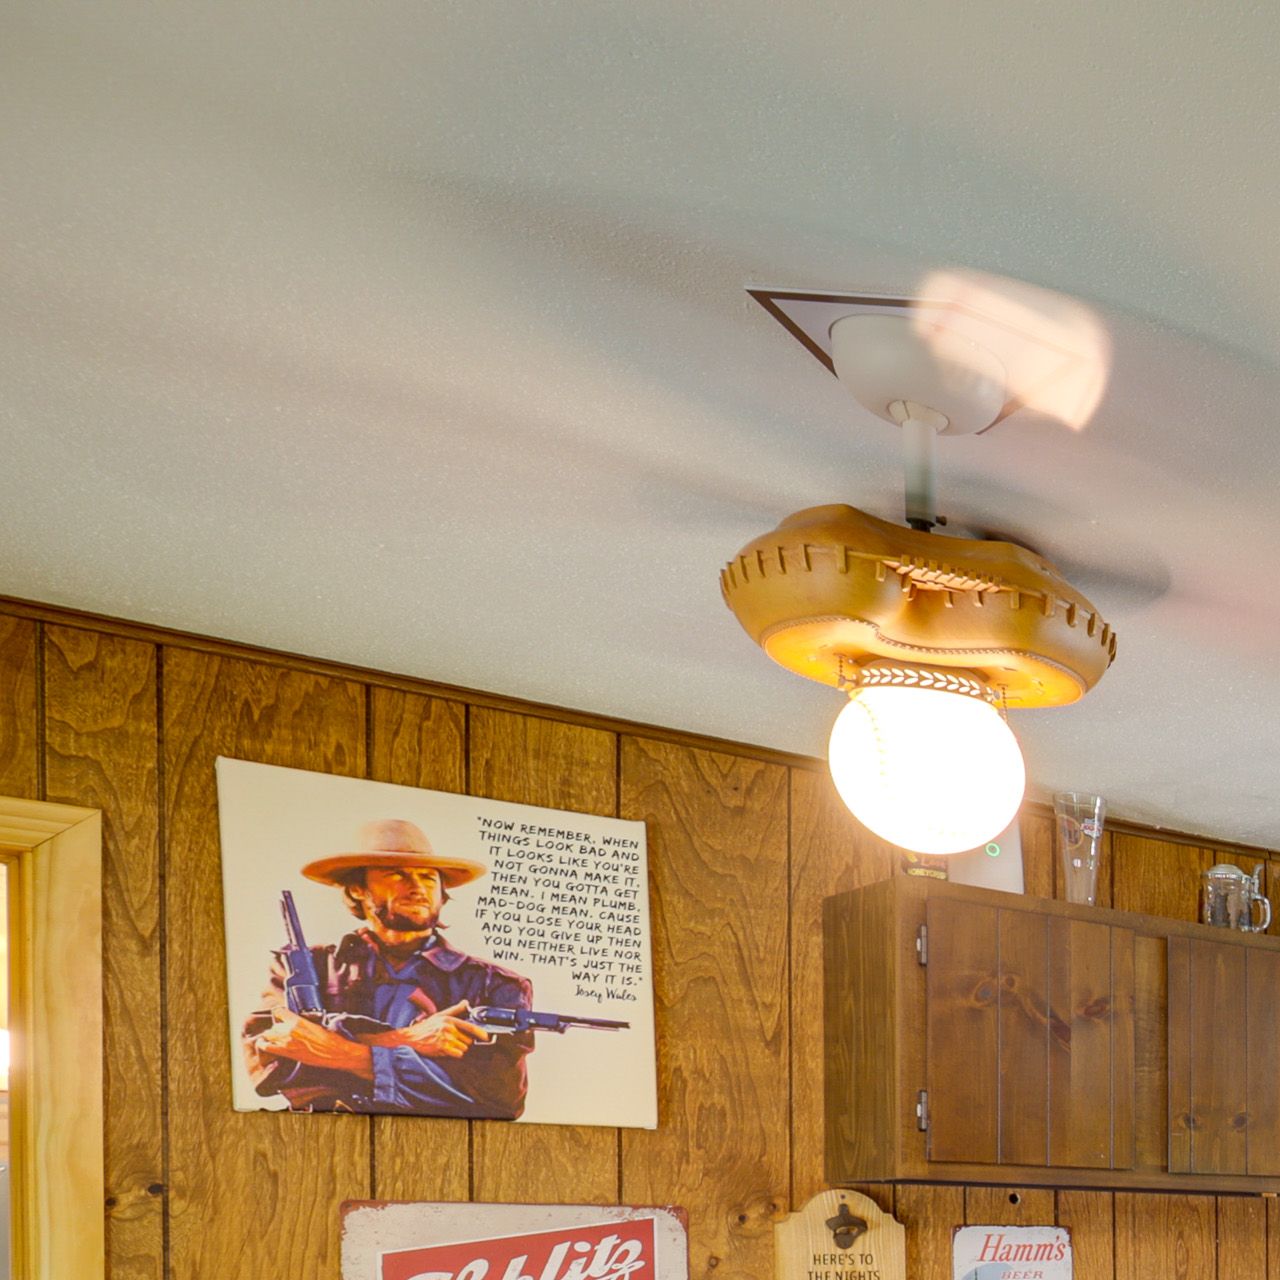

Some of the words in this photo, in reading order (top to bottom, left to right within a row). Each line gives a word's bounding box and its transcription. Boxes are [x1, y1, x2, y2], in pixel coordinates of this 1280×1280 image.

[479, 830, 530, 846] THINGS
[536, 840, 574, 852] LOOK
[580, 846, 606, 856] BAD
[612, 852, 640, 861] AND
[602, 836, 639, 849] WHEN
[490, 846, 502, 856] IT
[507, 849, 553, 863] LOOKS
[559, 856, 588, 868] LIKE
[593, 861, 639, 875] YOU'RE
[494, 860, 523, 872] NOT
[529, 865, 578, 879] GONNA
[584, 872, 619, 884] MAKE
[492, 872, 528, 884] THEN
[534, 878, 560, 889] YOU
[566, 882, 608, 896] GOTTA
[614, 889, 639, 899] GET
[477, 896, 546, 912] MAD-DOG
[599, 912, 640, 923] CAUSE
[551, 893, 588, 905] MEAN
[475, 909, 487, 918] IF
[493, 911, 521, 921] YOU
[527, 915, 561, 926] LOSE
[568, 920, 602, 932] YOUR
[607, 925, 641, 935] HEAD
[482, 922, 512, 933] AND
[518, 927, 545, 937] YOU
[551, 930, 581, 941] GIVE
[587, 935, 602, 944] UP
[607, 937, 642, 948] THEN
[484, 936, 511, 946] YOU
[517, 939, 576, 954] NEITHER
[580, 947, 609, 956] LIVE
[614, 951, 642, 961] NOR
[493, 951, 524, 961] WIN.
[530, 954, 577, 966] THAT'S
[583, 960, 613, 970] JUST
[618, 963, 642, 973] THE
[572, 972, 599, 982] WAY
[605, 972, 617, 985] IT
[575, 985, 602, 1003] Josey
[606, 987, 636, 1001] Wales
[813, 1254, 855, 1265] HERE'S
[860, 1254, 873, 1265] TO
[976, 1234, 1066, 1262] Hamm's
[1000, 1270, 1044, 1280] BEER
